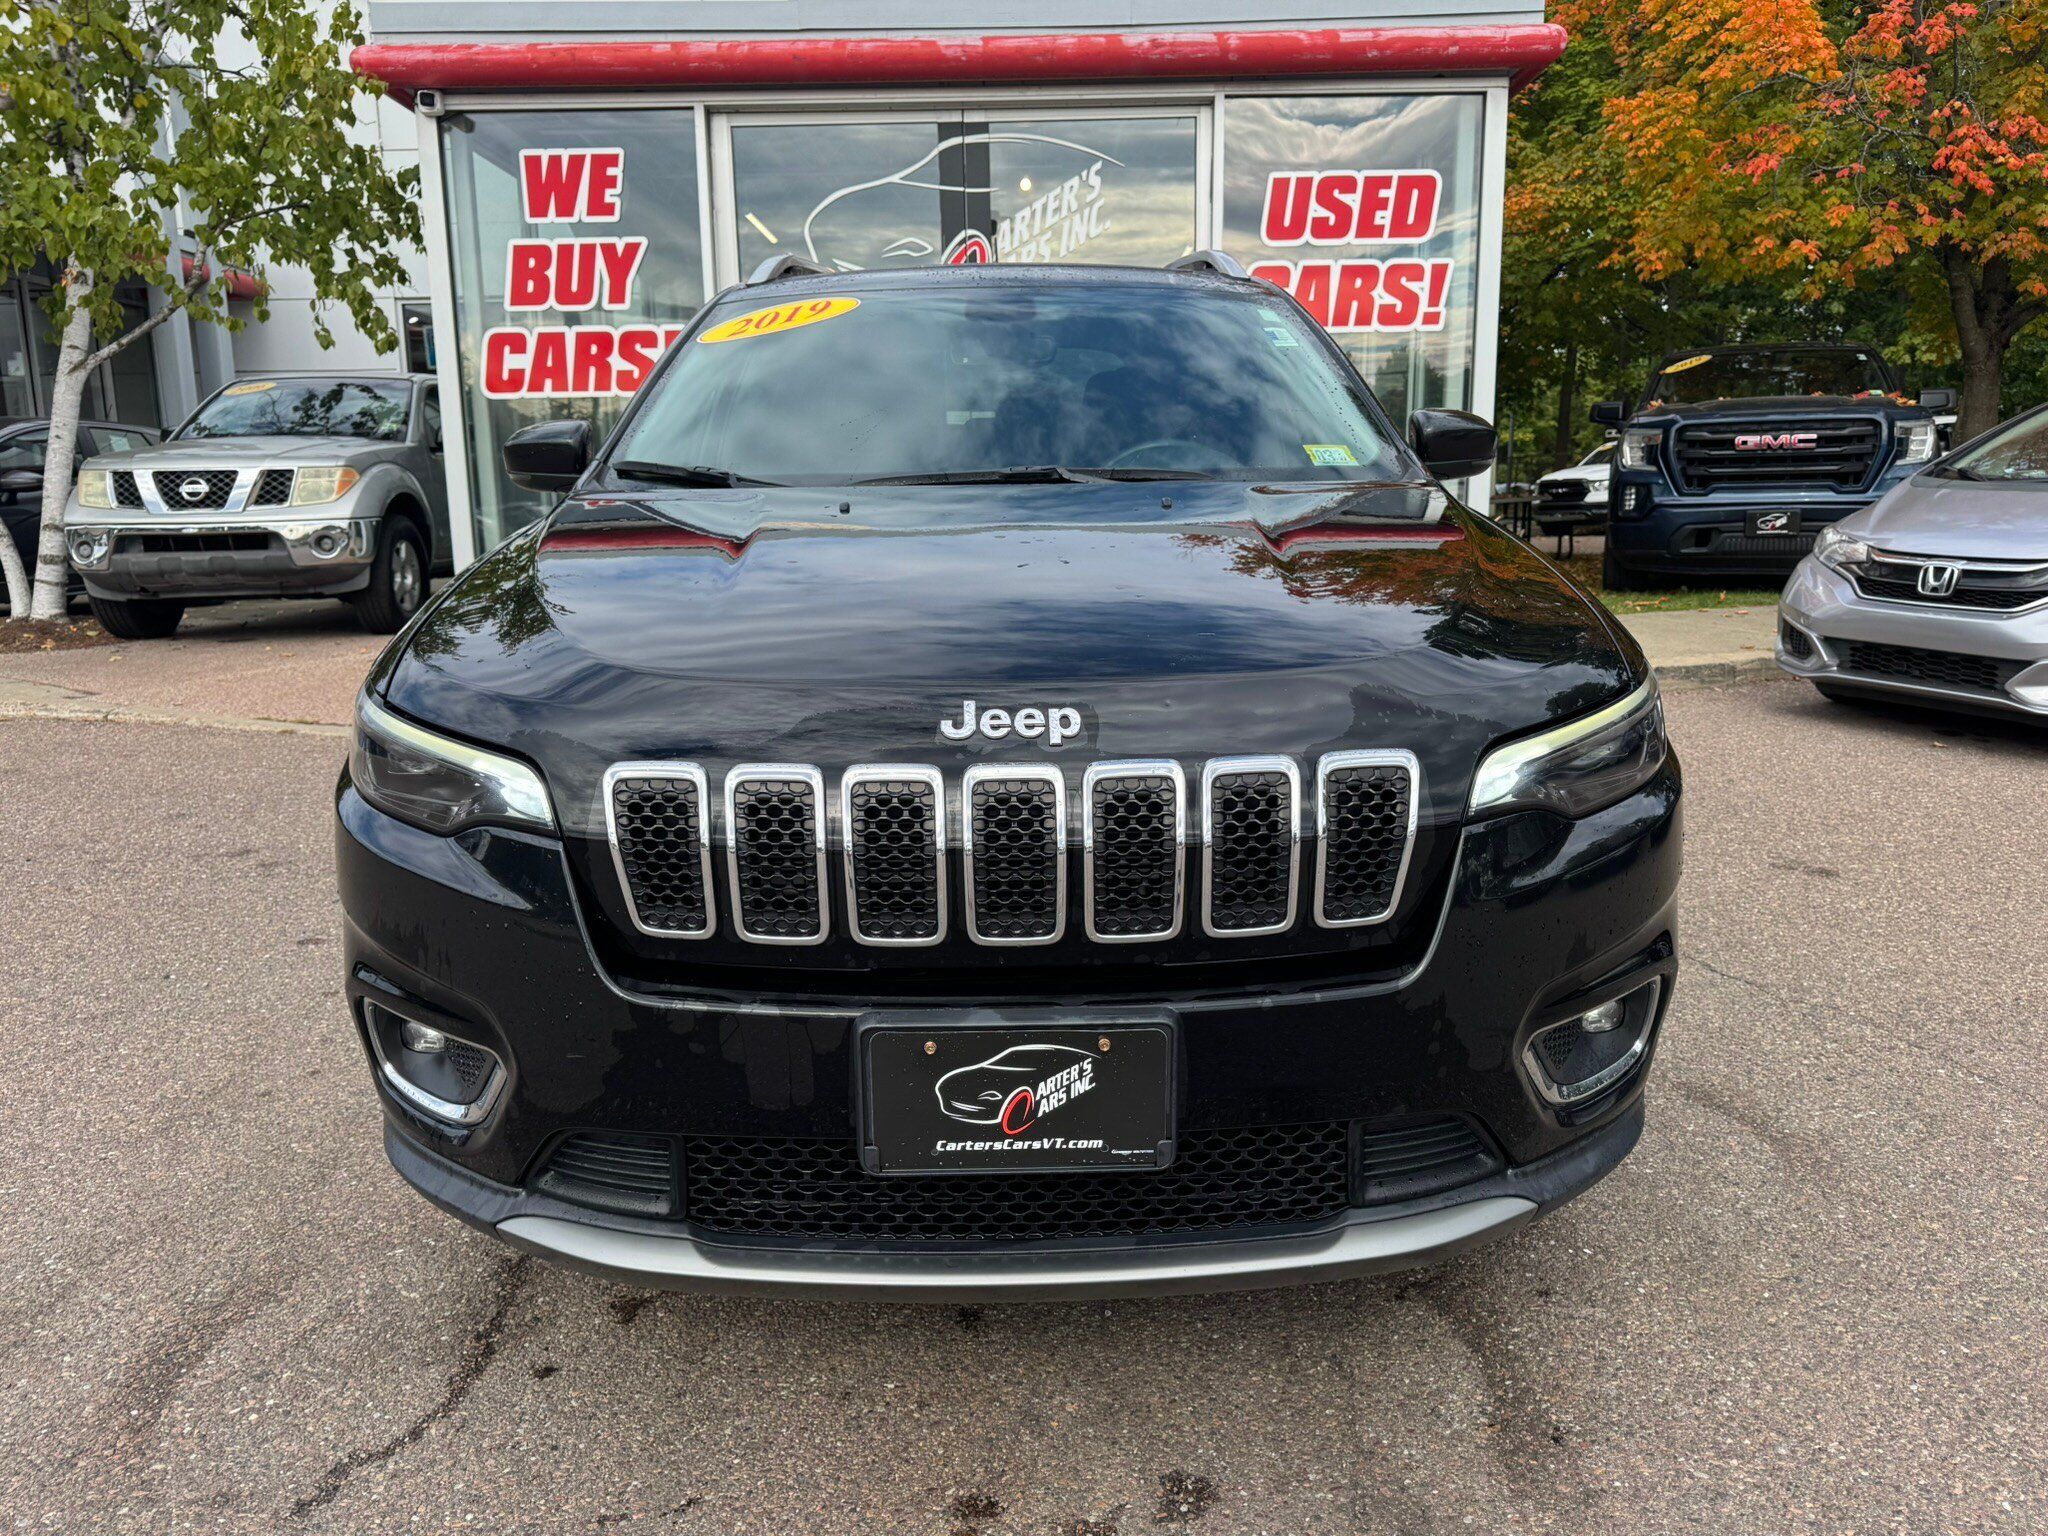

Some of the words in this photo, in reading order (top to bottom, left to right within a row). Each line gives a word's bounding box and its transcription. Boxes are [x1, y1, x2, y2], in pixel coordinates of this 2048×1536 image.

[520, 149, 624, 223] WE
[1262, 170, 1441, 245] USED
[505, 237, 647, 310] BUY
[727, 300, 832, 338] 2019
[481, 325, 684, 398] CARS
[1735, 433, 1818, 450] GMC
[940, 700, 1082, 747] Jeep
[936, 1138, 1104, 1152] CartersCarsVT.com
